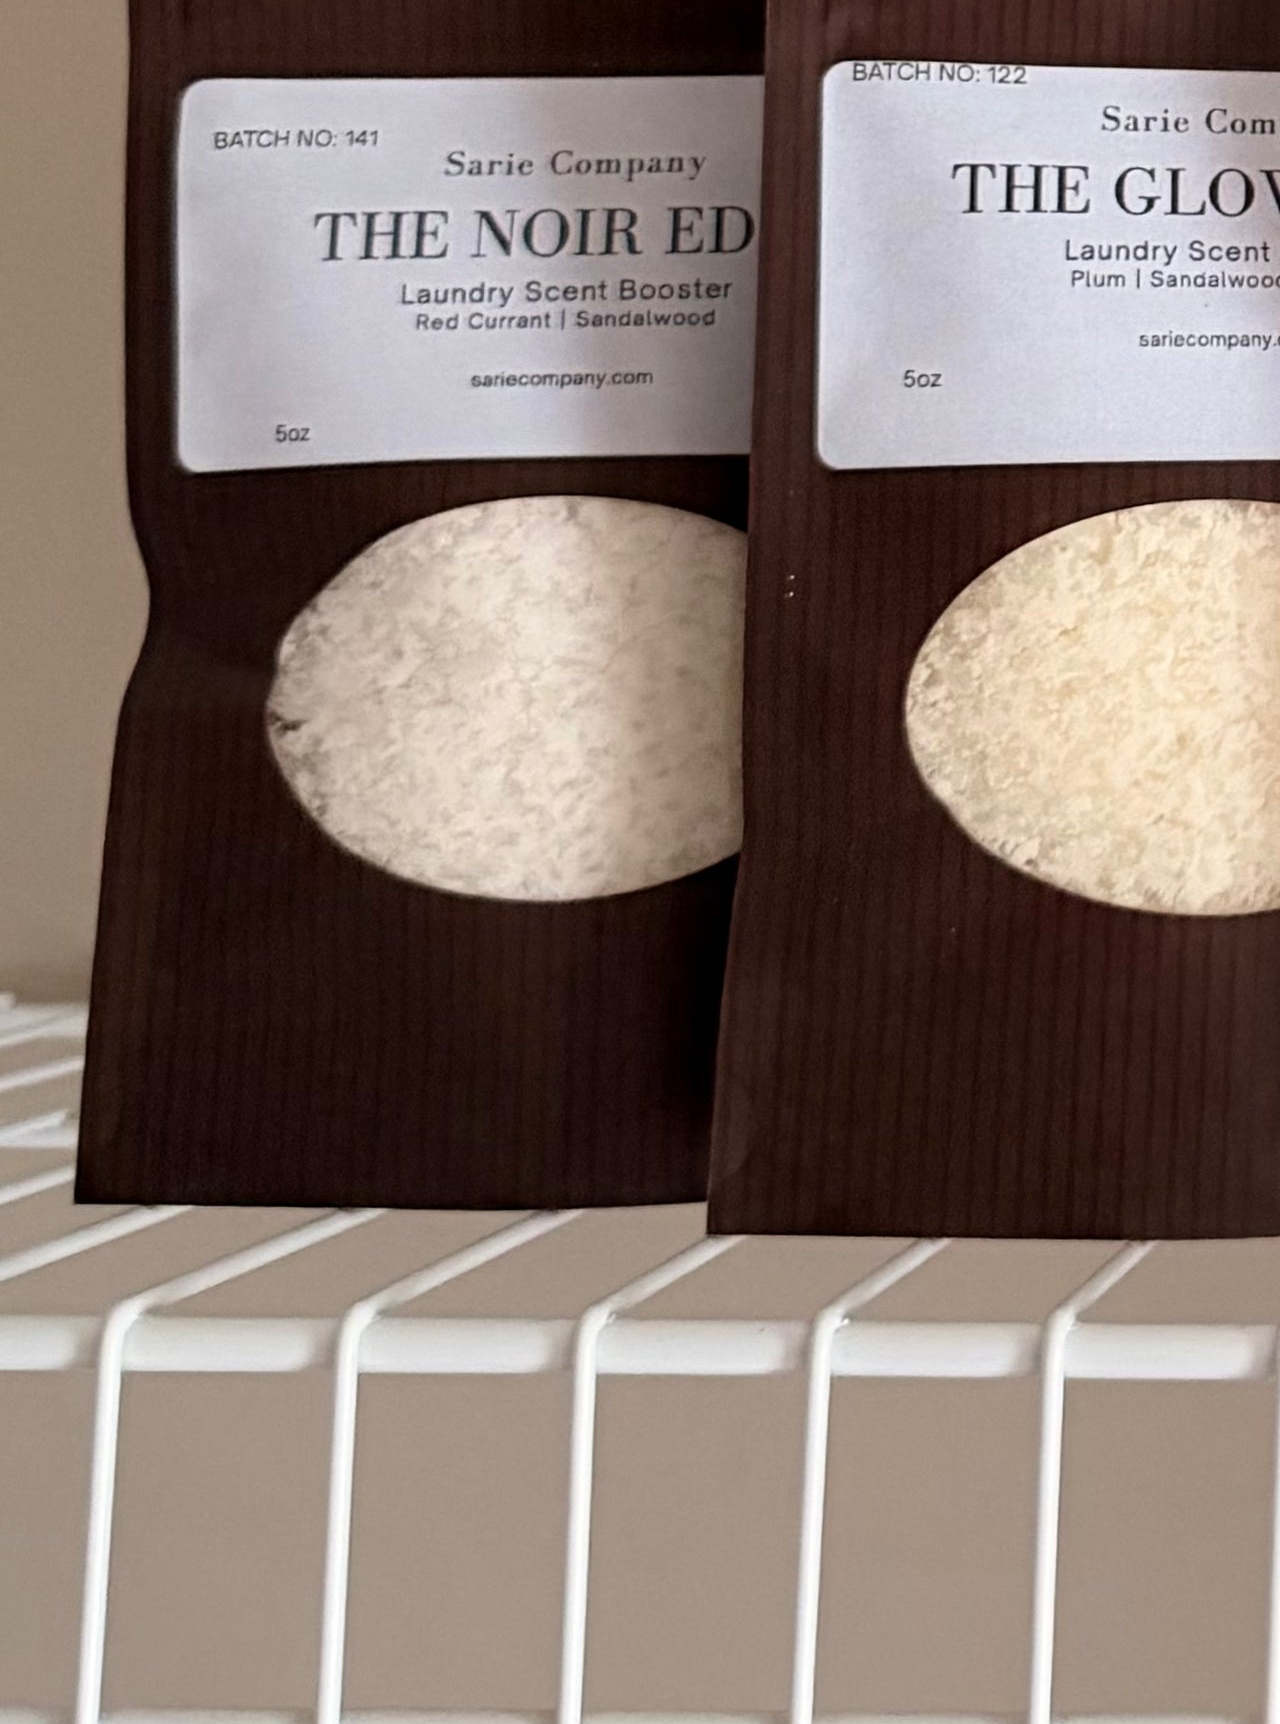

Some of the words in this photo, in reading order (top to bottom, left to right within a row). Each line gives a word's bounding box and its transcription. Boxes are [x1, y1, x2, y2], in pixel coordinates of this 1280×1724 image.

[852, 62, 931, 81] BATCH
[939, 64, 980, 82] NO:
[987, 66, 1027, 84] 122
[1101, 105, 1189, 133] Sarie
[213, 130, 290, 150] BATCH
[297, 129, 336, 147] NO:
[345, 130, 378, 146] 141
[444, 151, 533, 176] Sarie
[549, 150, 706, 183] Company
[951, 163, 1090, 214] THE
[314, 210, 449, 261] THE
[470, 208, 643, 258] NOIR
[1065, 239, 1177, 266] Laundry
[1188, 240, 1270, 262] Scent
[1071, 270, 1126, 287] Plum
[400, 282, 514, 308] Laundry
[524, 280, 607, 303] Scent
[617, 278, 732, 301] Booster
[416, 313, 459, 330] Red
[468, 312, 551, 330] Currant
[573, 309, 715, 329] Sandalwood
[470, 370, 653, 389] sariecompany.com
[903, 369, 942, 388] 5oz
[275, 424, 310, 443] 5oz
